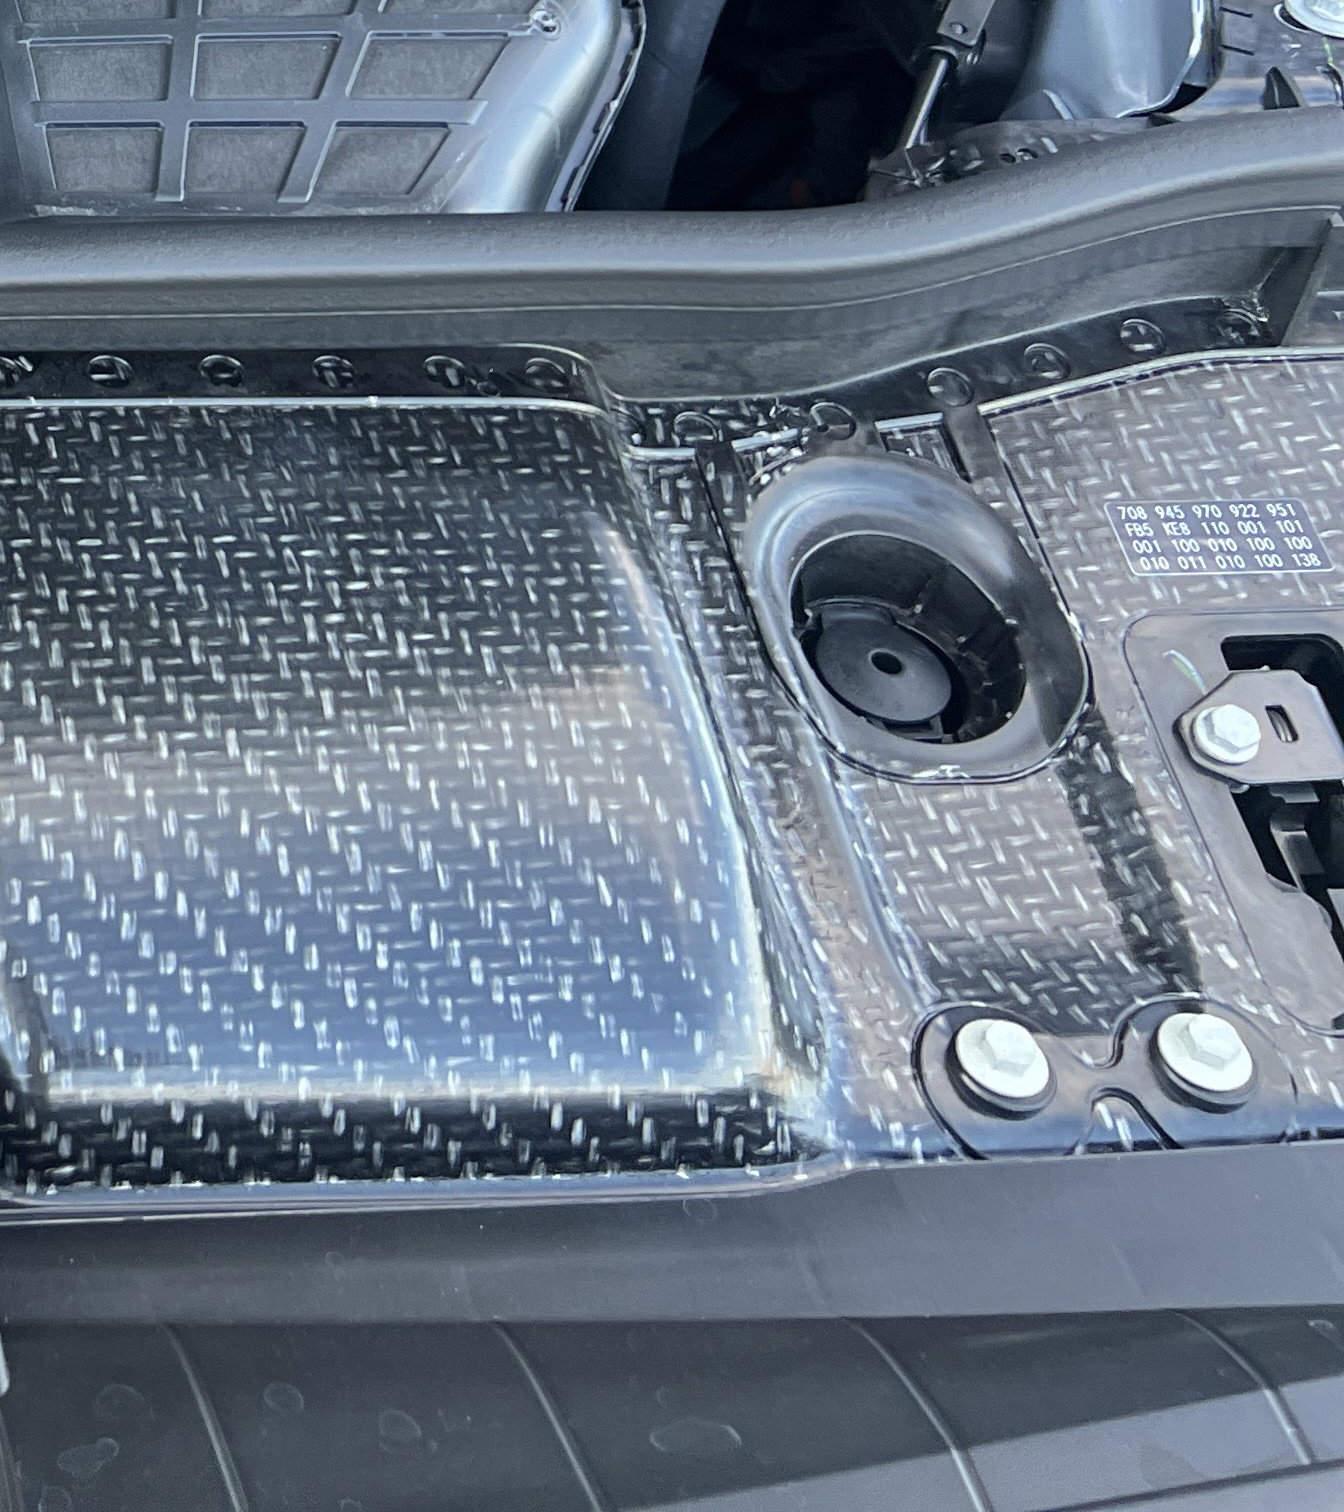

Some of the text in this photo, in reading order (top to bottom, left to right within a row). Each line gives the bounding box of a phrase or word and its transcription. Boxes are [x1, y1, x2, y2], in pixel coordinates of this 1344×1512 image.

[1117, 503, 1297, 520] 708 945 970 922 951
[1125, 520, 1305, 538] FB5 KE8 110 001 101
[1132, 536, 1313, 554] 001 100 010 100 100
[1140, 553, 1322, 571] 010 011 010 100 138
